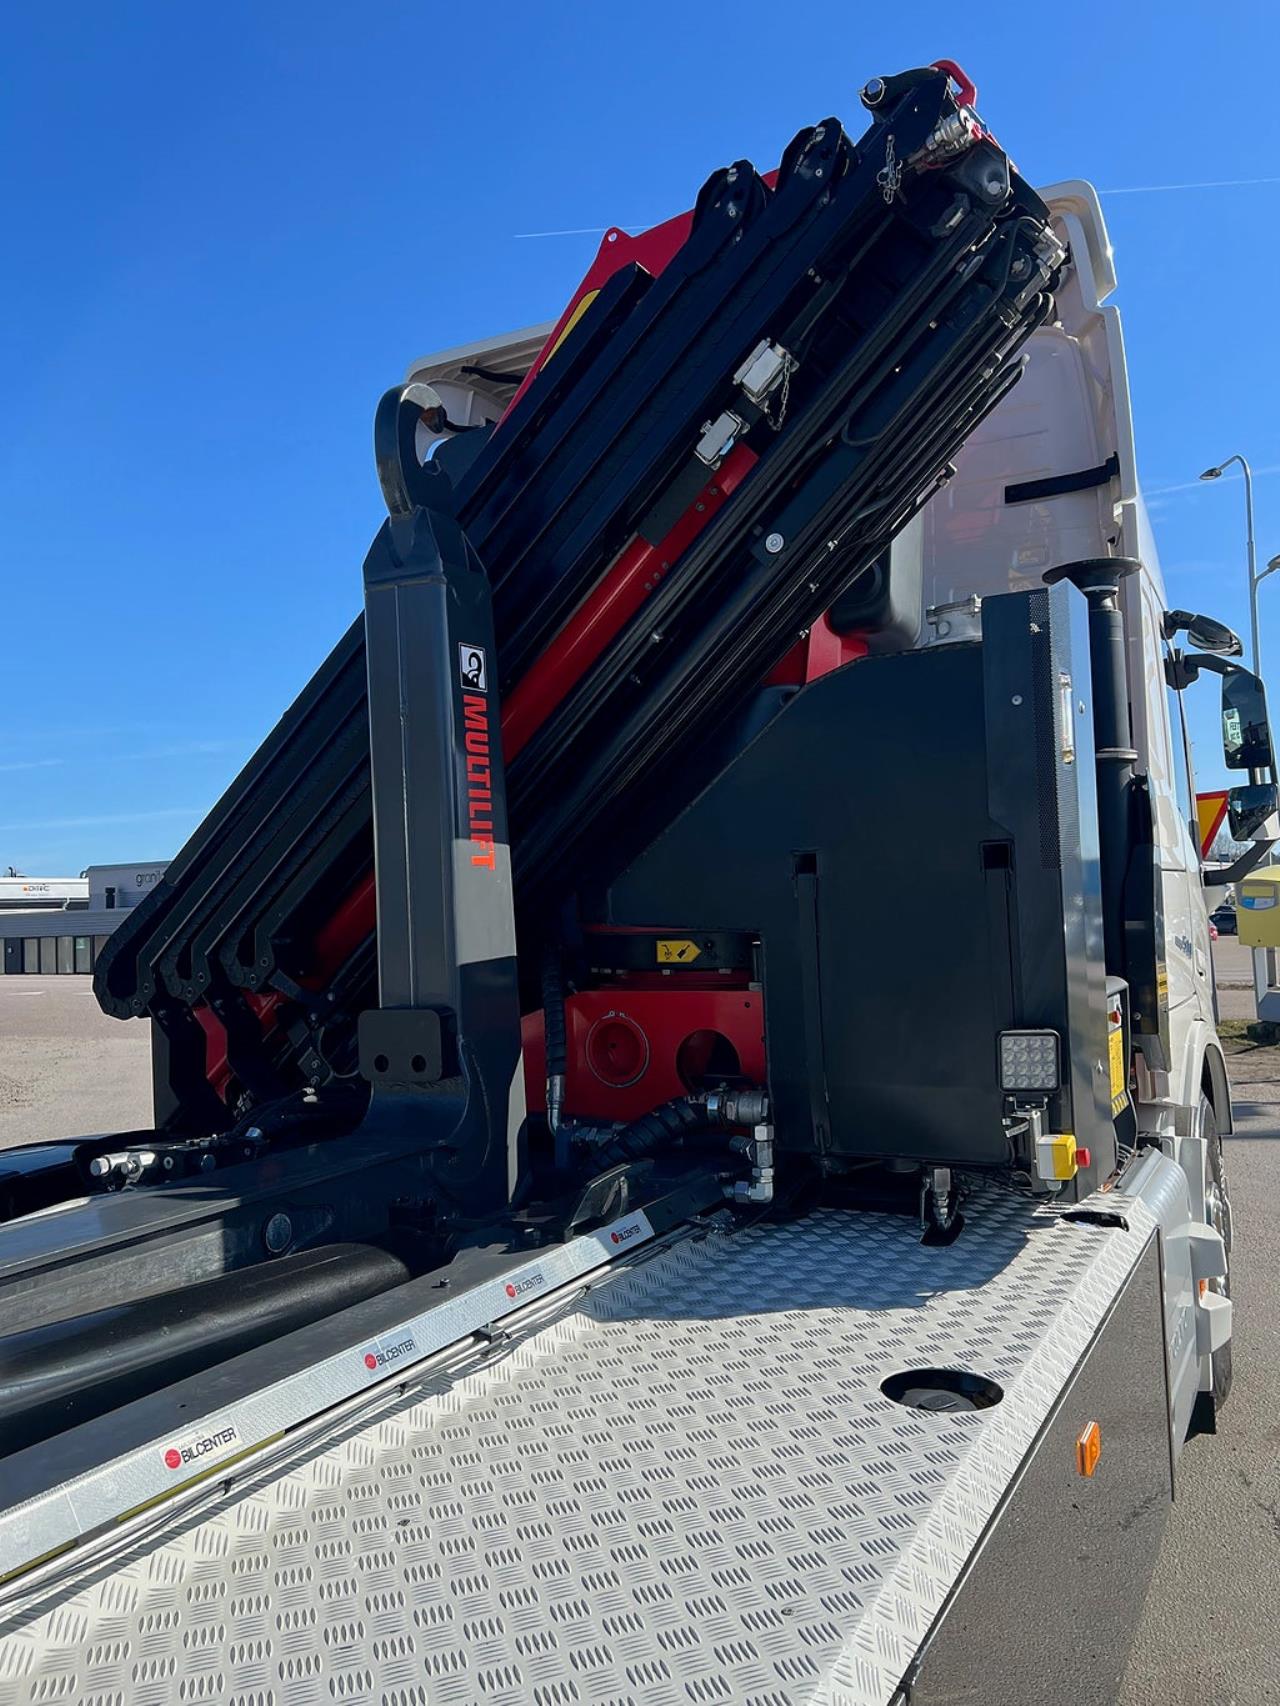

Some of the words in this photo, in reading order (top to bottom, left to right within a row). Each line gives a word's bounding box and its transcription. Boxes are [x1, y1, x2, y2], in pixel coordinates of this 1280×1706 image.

[463, 694, 496, 871] MULTILIFT
[515, 1274, 545, 1296] BILCENTER
[376, 1339, 416, 1366] BILCENTER
[180, 1427, 237, 1463] BILCENTER
